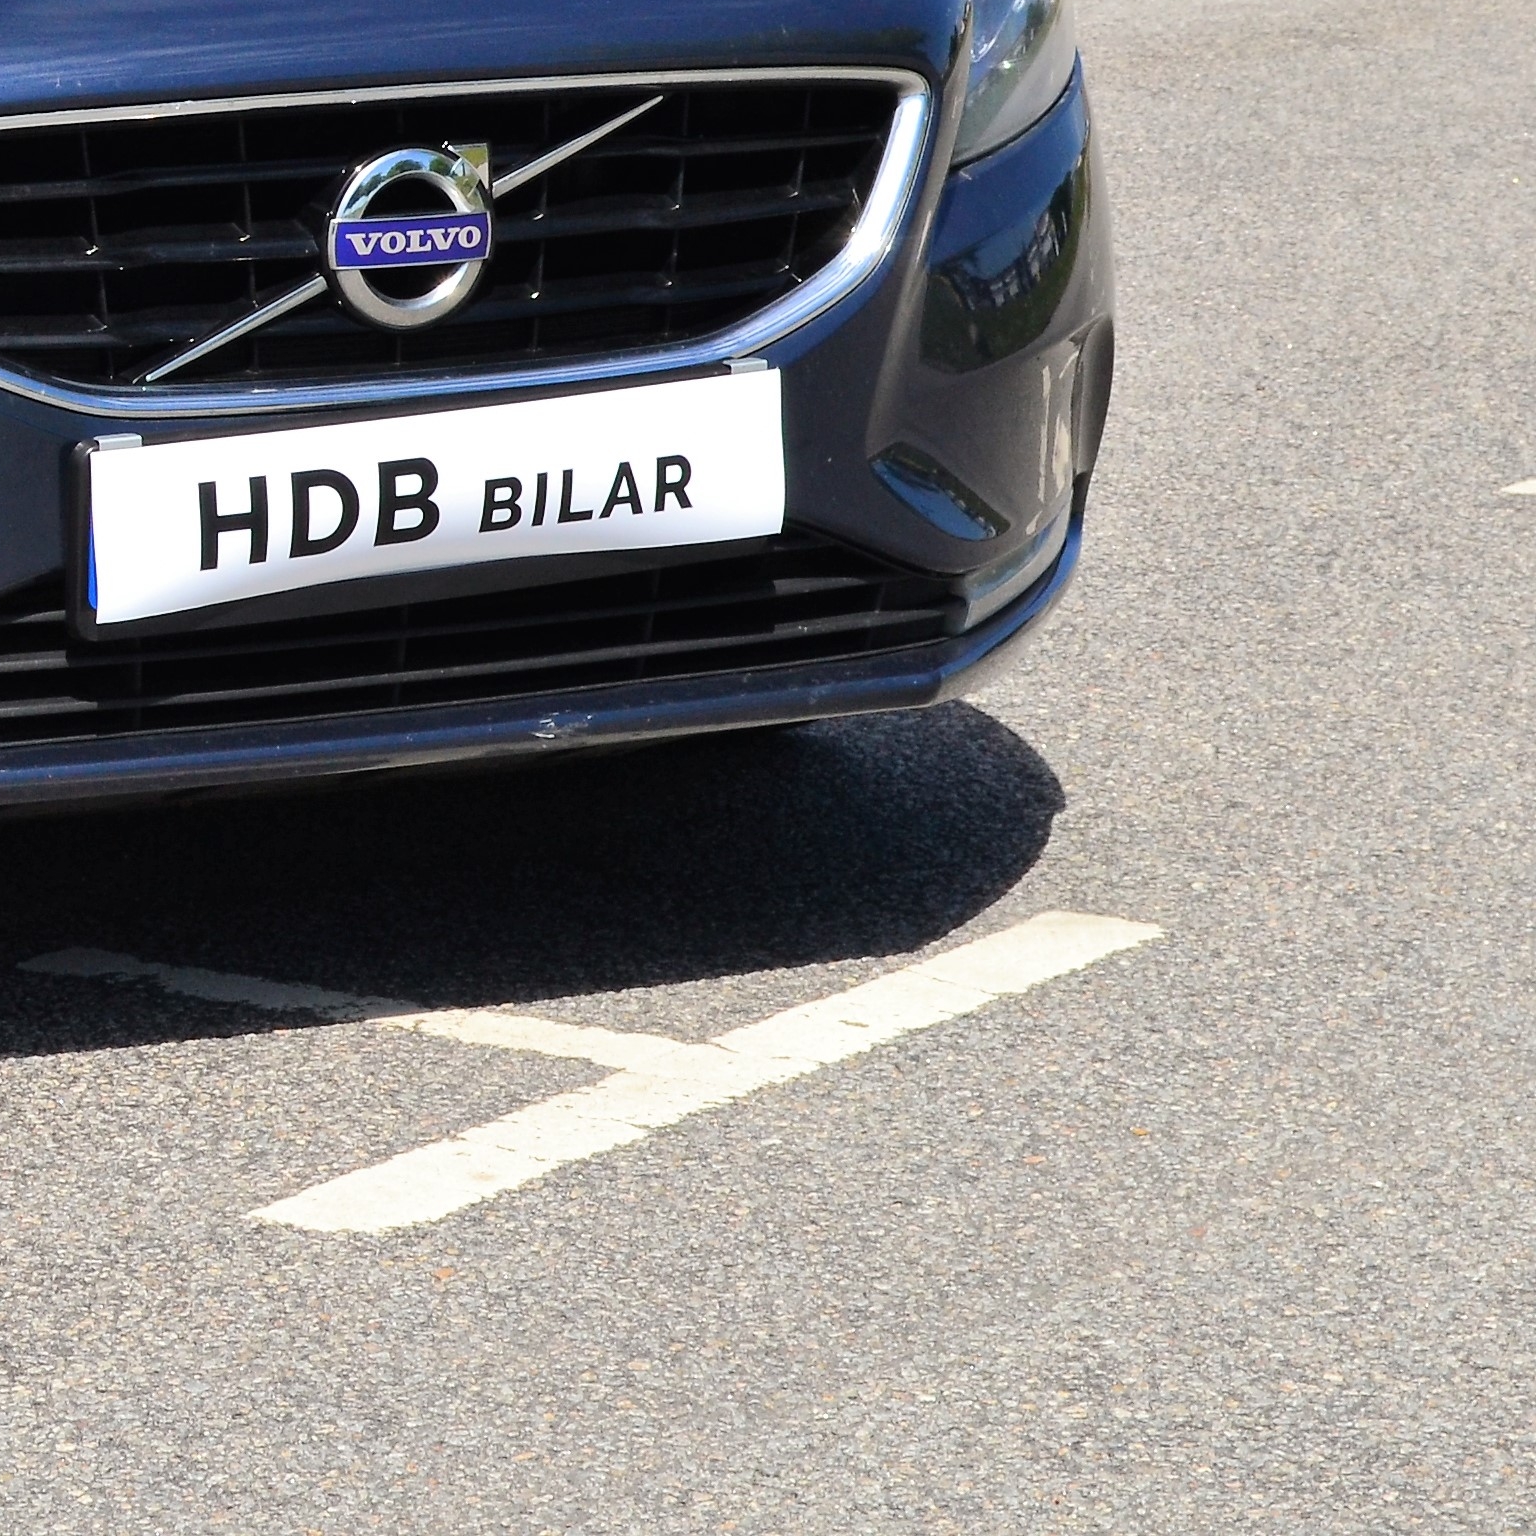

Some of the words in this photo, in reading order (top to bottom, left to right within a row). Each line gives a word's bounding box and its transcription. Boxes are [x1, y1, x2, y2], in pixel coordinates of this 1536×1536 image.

[345, 225, 482, 256] VOLVO
[197, 456, 442, 572] HDB
[478, 453, 694, 535] BILAR
